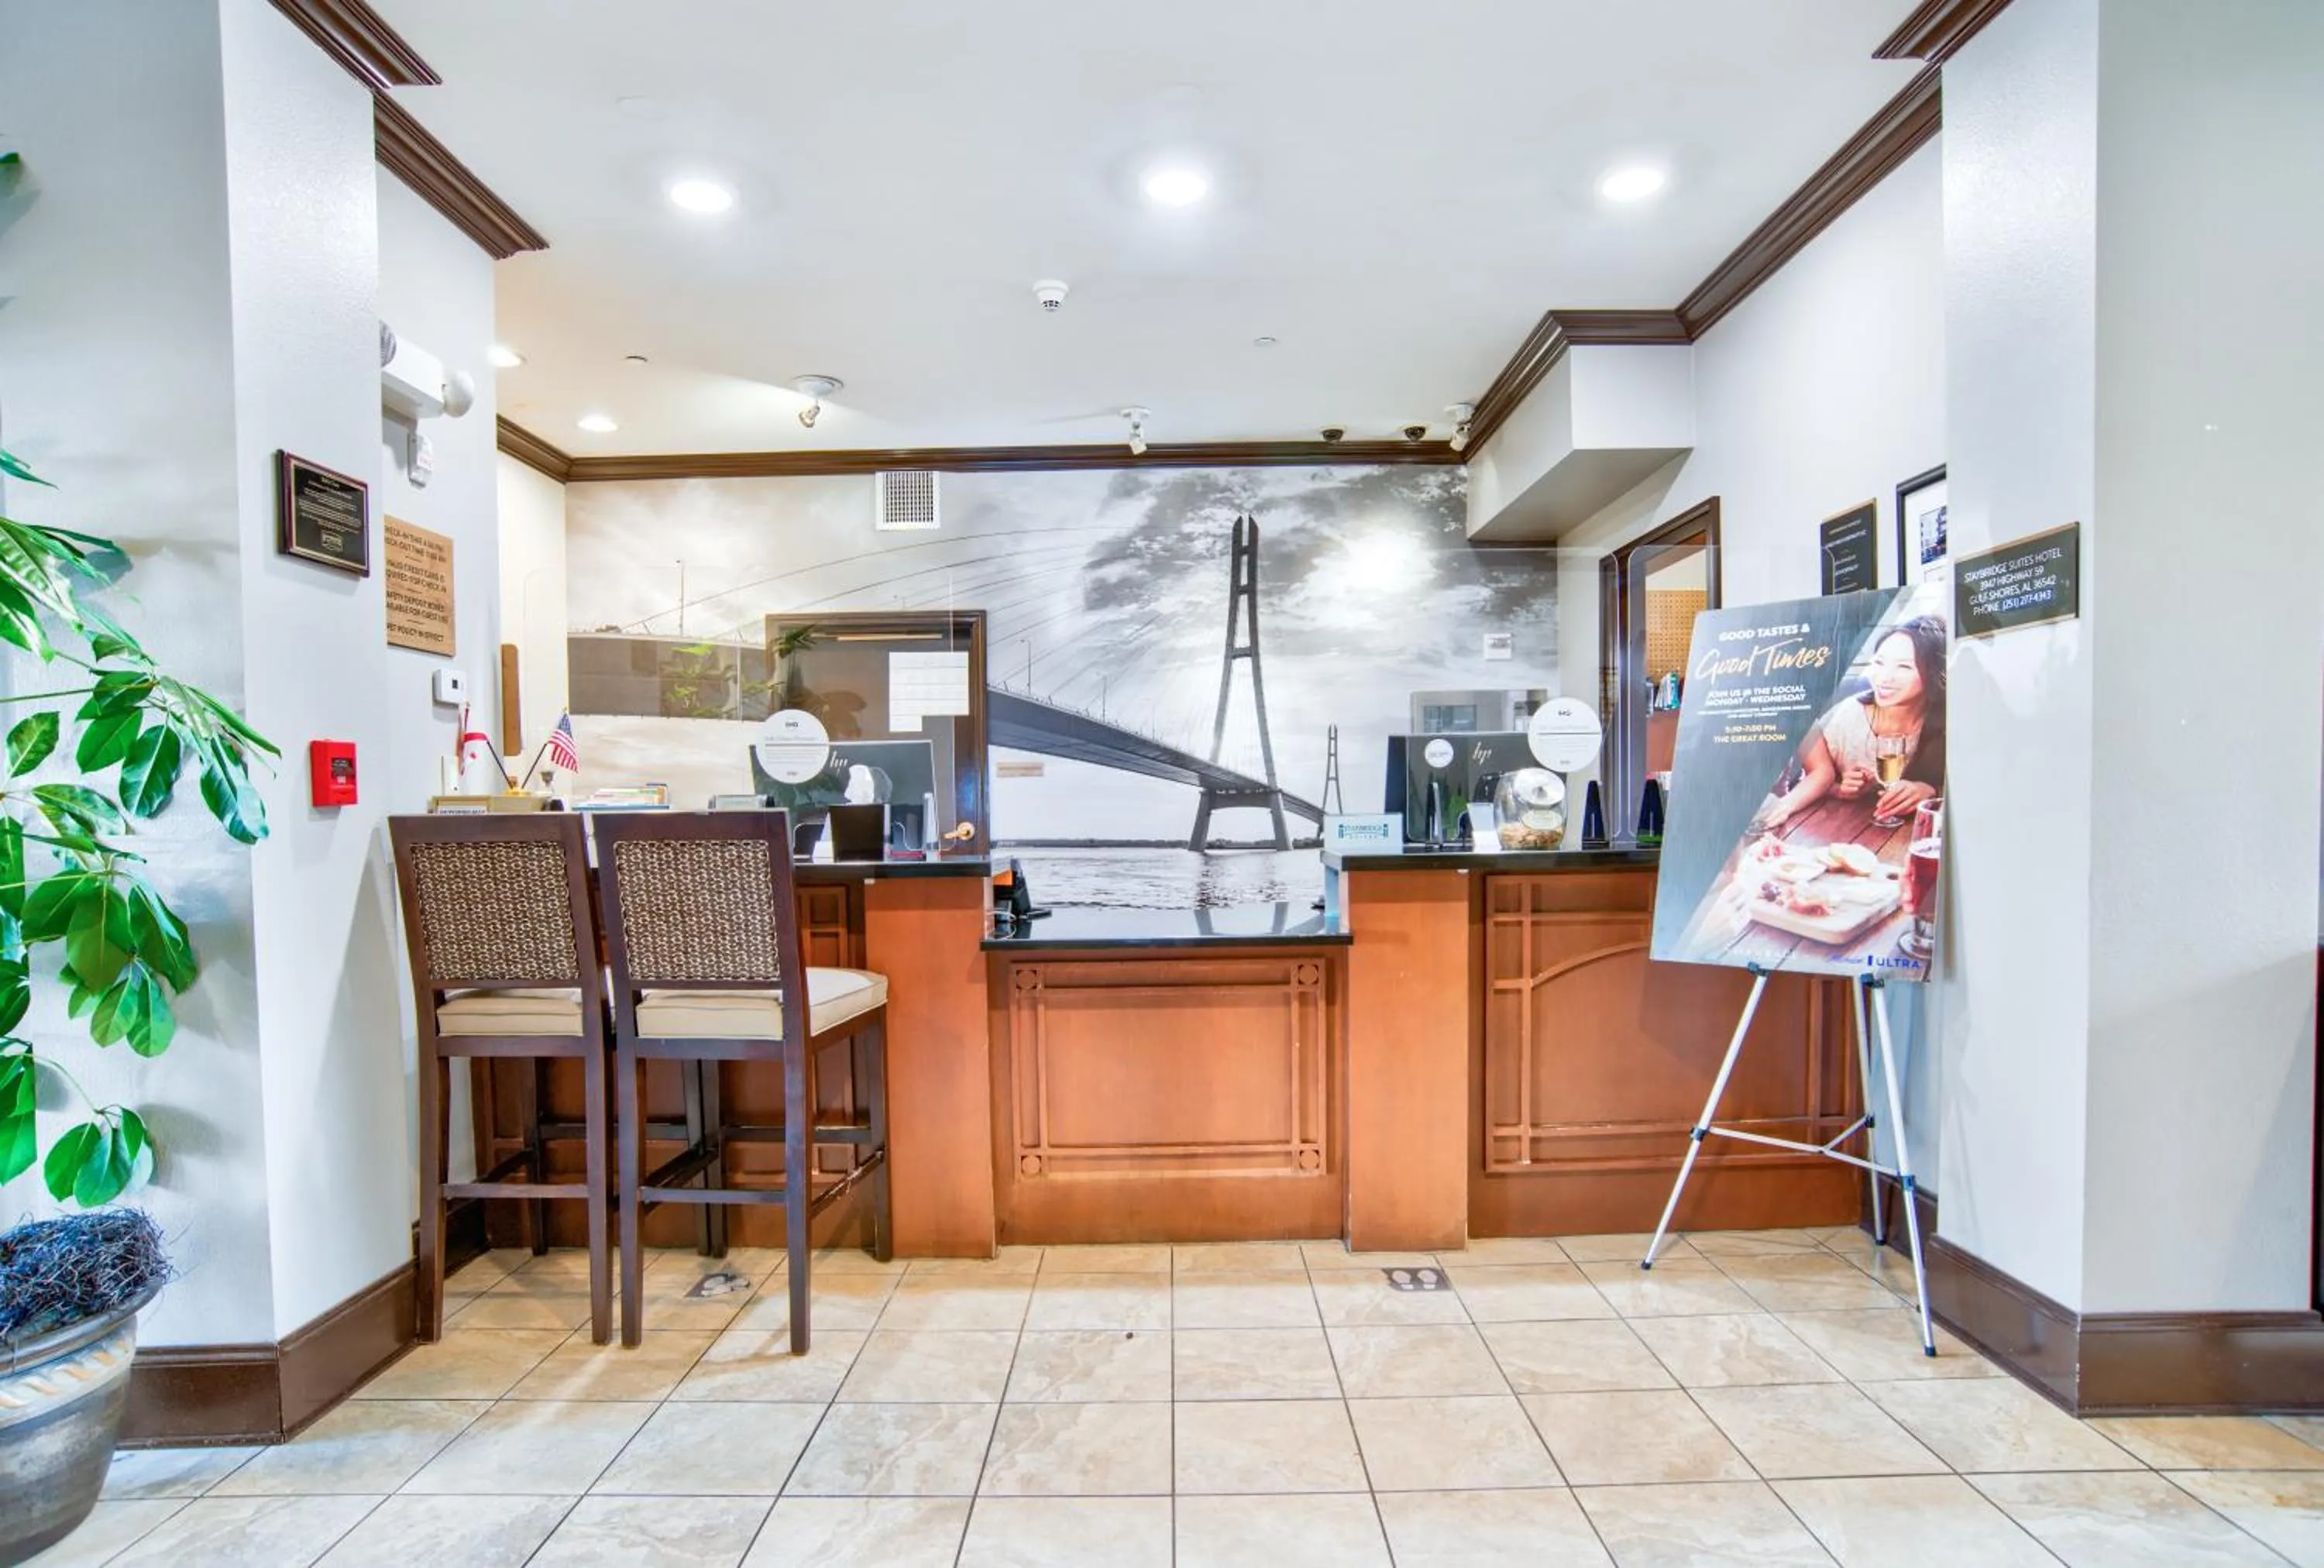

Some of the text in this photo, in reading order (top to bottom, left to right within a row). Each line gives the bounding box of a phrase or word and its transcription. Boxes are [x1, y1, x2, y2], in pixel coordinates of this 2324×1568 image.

[1964, 548, 2062, 583] STAYBRIDGE SUITES HOTEL
[1996, 568, 2033, 586] HIGHWAY
[2034, 566, 2045, 576] 59
[2021, 580, 2032, 592] AL
[1718, 623, 1810, 641] GOOD TASTES &
[1694, 638, 1833, 686] Good Times
[1708, 689, 1728, 699] JOIN
[1730, 689, 1741, 697] US
[1754, 687, 1771, 696] THE
[1772, 685, 1807, 694] SOCIAL
[1704, 697, 1744, 707] MONDAY
[1750, 693, 1807, 704] WEDNESDAY
[1758, 733, 1786, 742] ROOM
[1876, 958, 1920, 968] ULTRA
